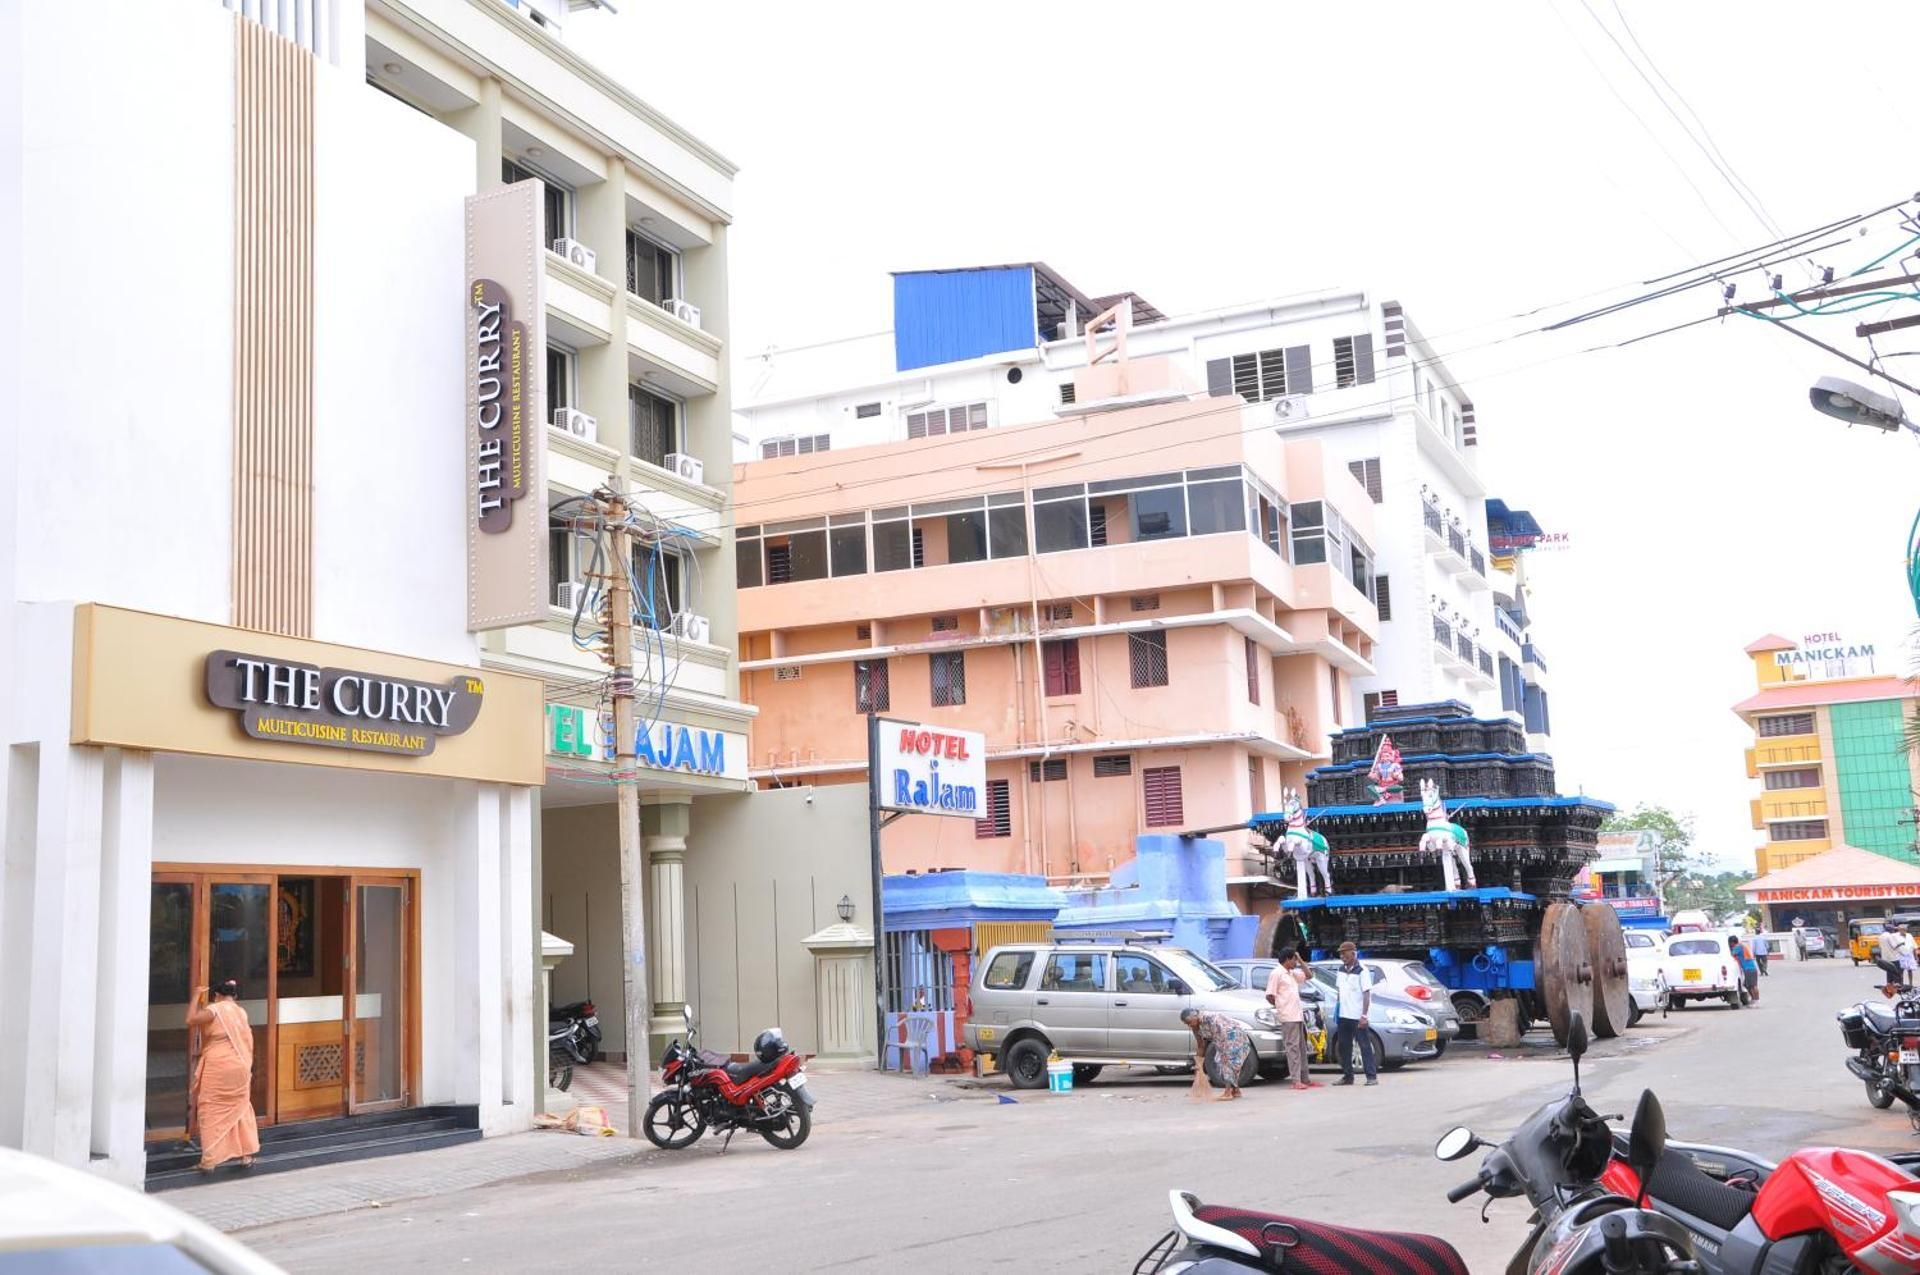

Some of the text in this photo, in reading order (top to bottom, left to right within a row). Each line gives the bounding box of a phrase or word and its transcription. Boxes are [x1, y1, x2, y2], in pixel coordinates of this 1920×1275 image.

[475, 283, 502, 518] THE CURRY TM
[512, 329, 521, 489] MULTICUISINE RESTAURANT
[1541, 532, 1569, 543] PARK
[1777, 644, 1875, 665] MANICKAM
[1804, 632, 1842, 644] HOTEL
[236, 658, 484, 727] THE CURRY TM
[256, 717, 427, 751] MULTICUISINE RESTAURANT
[545, 703, 592, 756] EL
[899, 728, 970, 760] HOTEL
[894, 759, 977, 810] Rajam
[1837, 885, 1892, 898] TOURIST
[1688, 1231, 1719, 1256] YAMAHA
